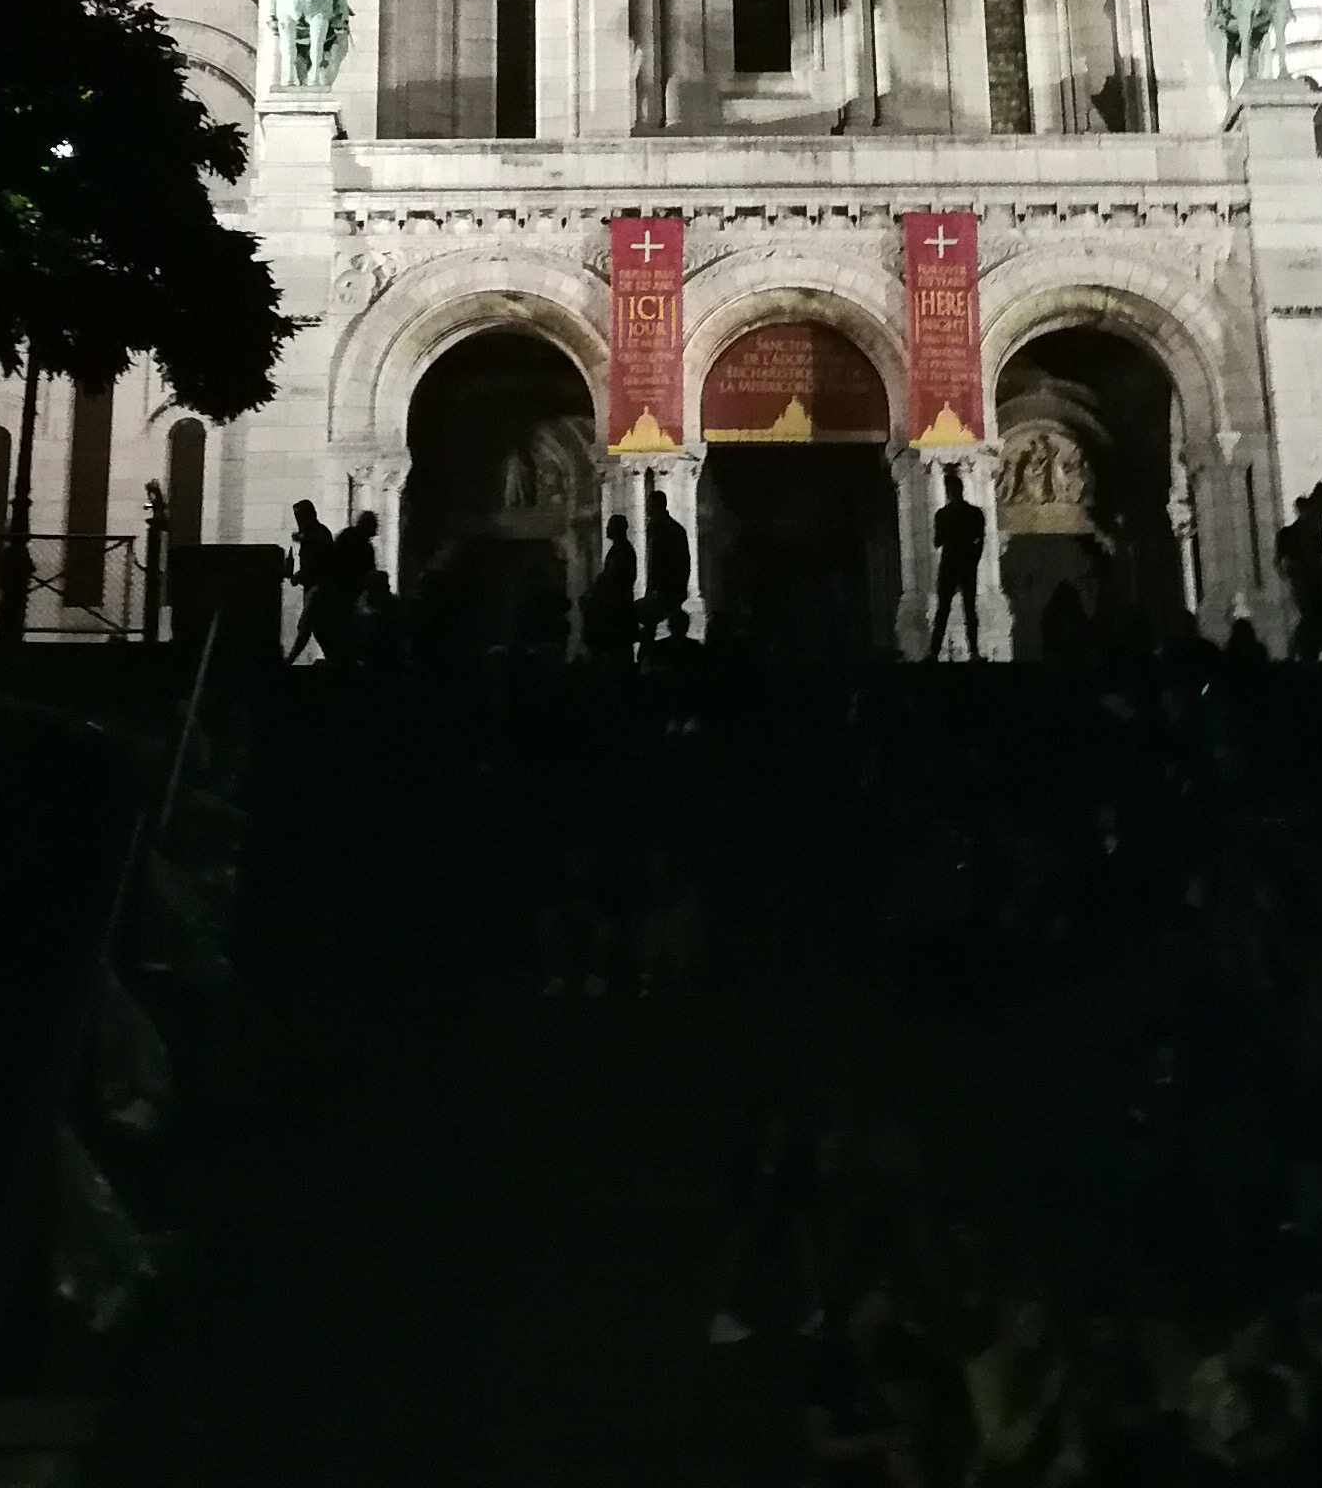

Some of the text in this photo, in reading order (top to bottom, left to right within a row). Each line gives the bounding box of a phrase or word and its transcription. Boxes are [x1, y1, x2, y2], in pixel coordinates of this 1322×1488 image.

[629, 295, 666, 321] ICI
[921, 290, 967, 317] HERE
[628, 321, 667, 340] JOUR
